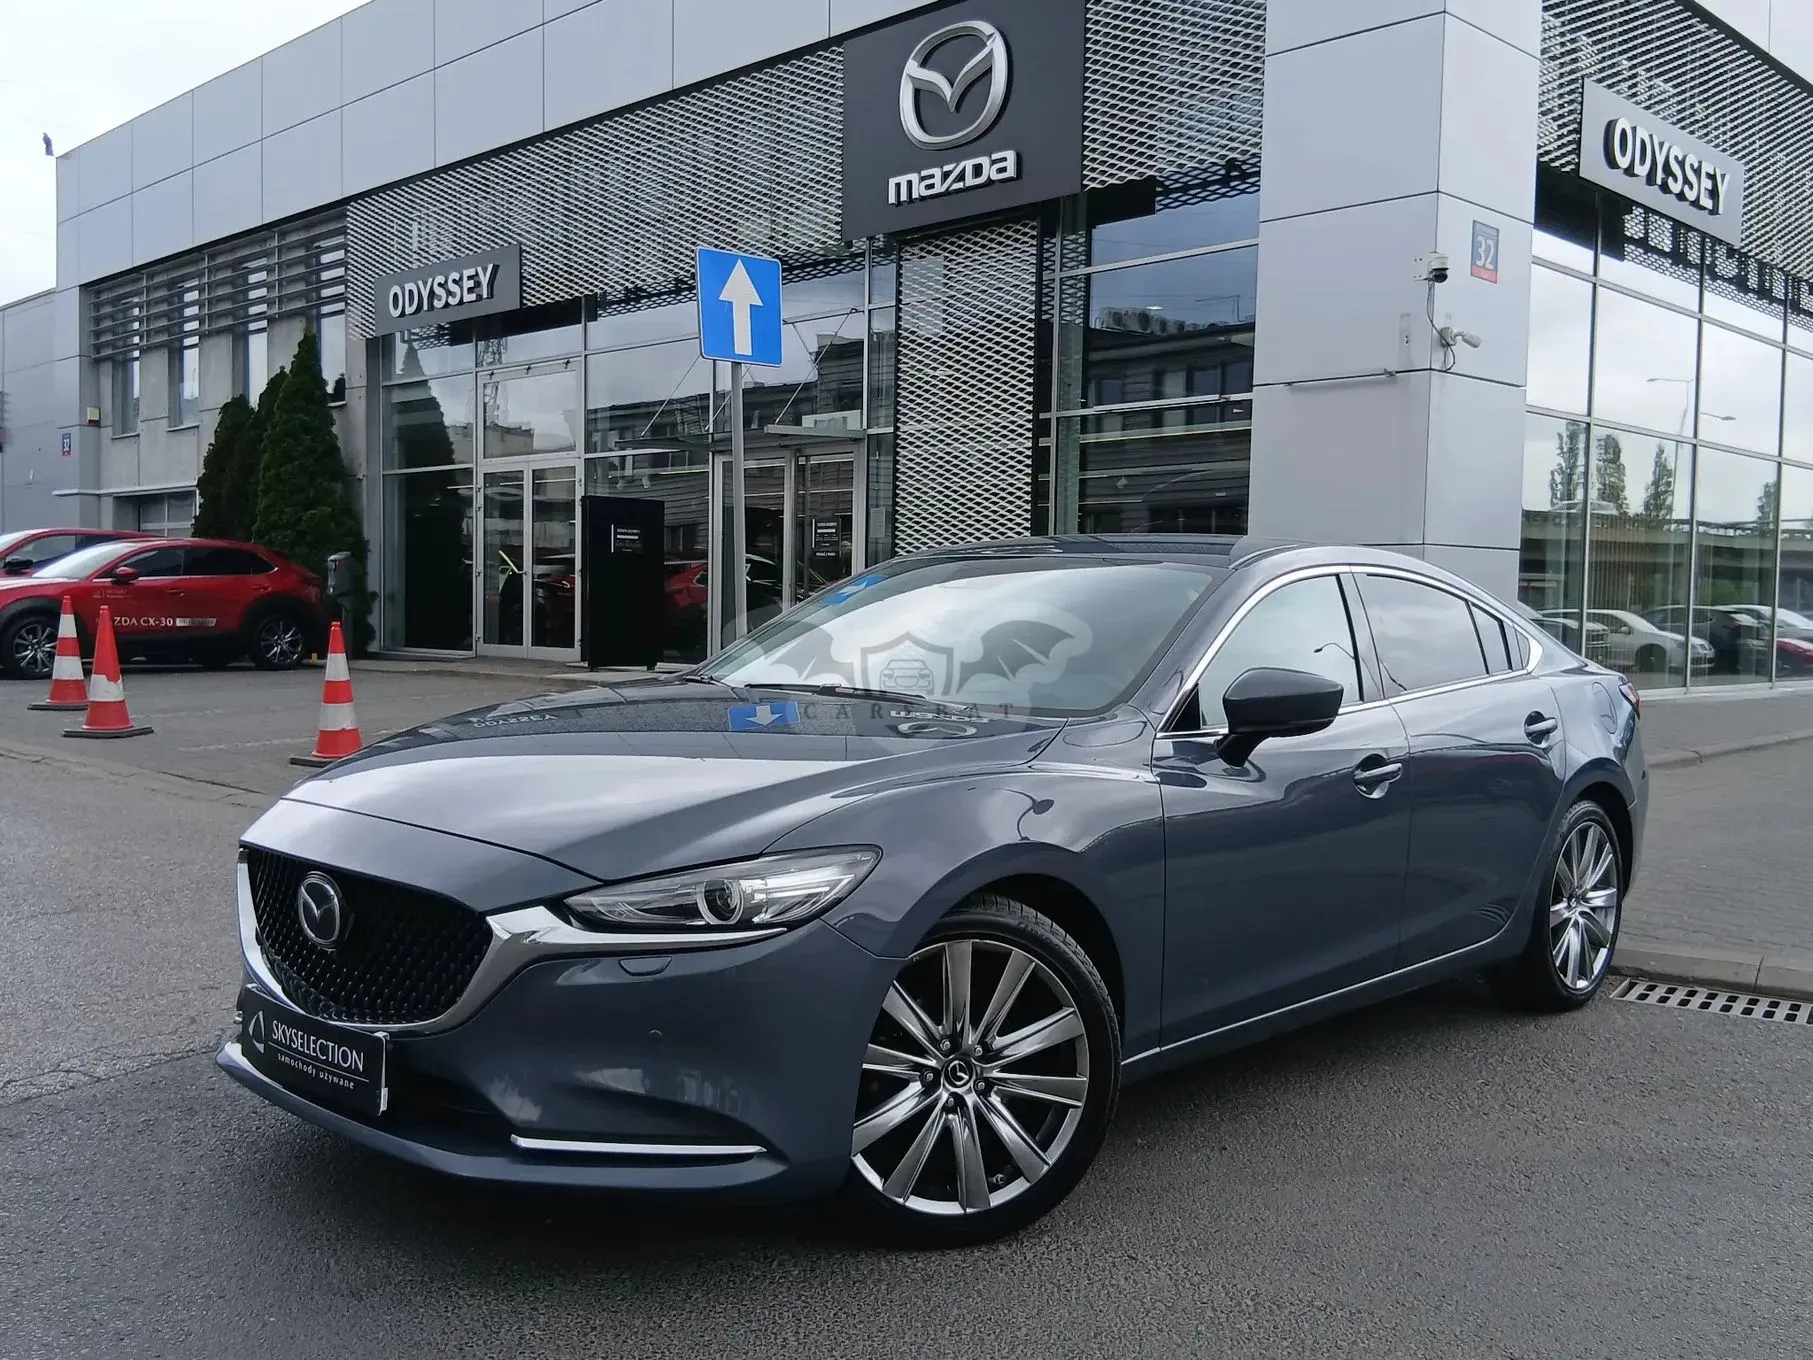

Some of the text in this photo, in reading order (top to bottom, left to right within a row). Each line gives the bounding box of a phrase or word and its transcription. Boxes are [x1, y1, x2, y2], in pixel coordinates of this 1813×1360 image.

[888, 150, 1018, 204] mazda
[1608, 117, 1730, 215] ODYSSEY
[1475, 235, 1494, 270] 32
[388, 263, 497, 318] ODYSSEY
[140, 616, 173, 627] CX-30
[271, 1019, 365, 1072] SKYSELECTION
[277, 1053, 355, 1090] samochody używane
